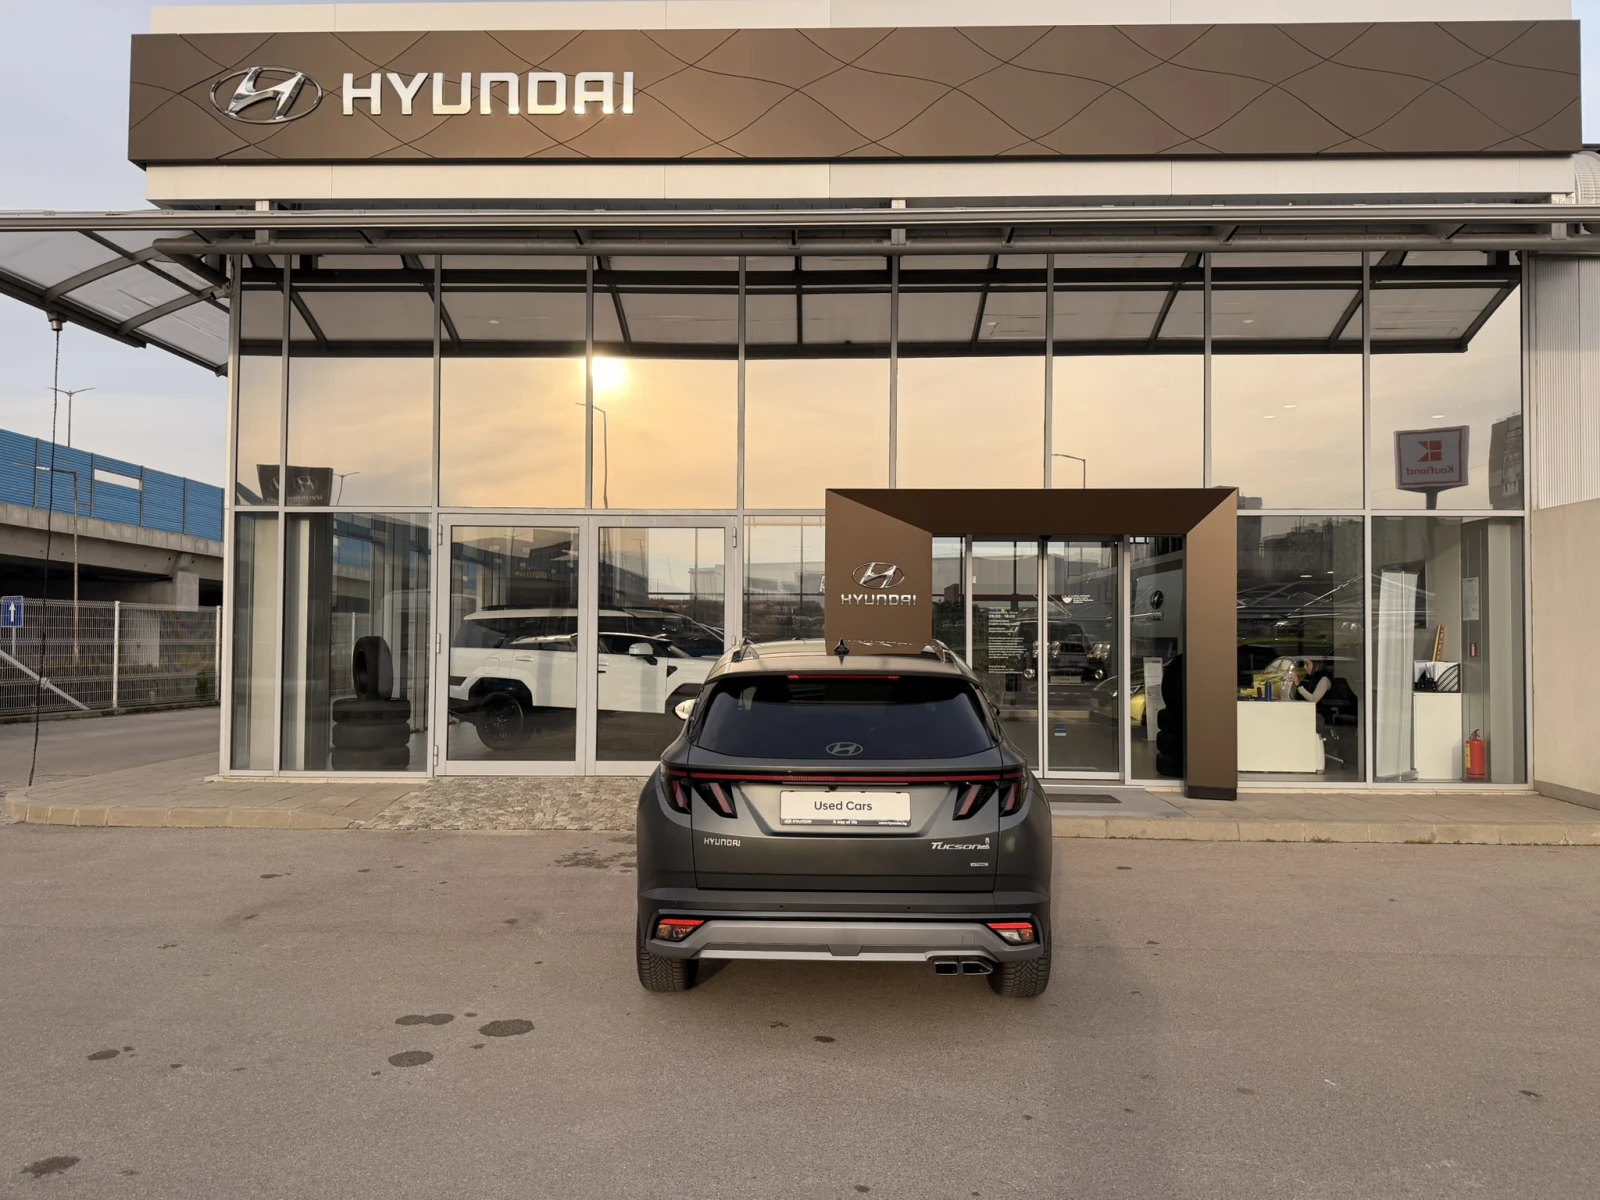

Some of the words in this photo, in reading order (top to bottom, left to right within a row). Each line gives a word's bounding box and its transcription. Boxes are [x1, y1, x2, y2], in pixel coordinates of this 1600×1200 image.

[342, 71, 635, 116] HYUNDAI
[840, 593, 917, 606] HYUNDAI
[814, 800, 843, 811] Used
[845, 800, 873, 811] Cars
[703, 837, 741, 847] HYUNDAI
